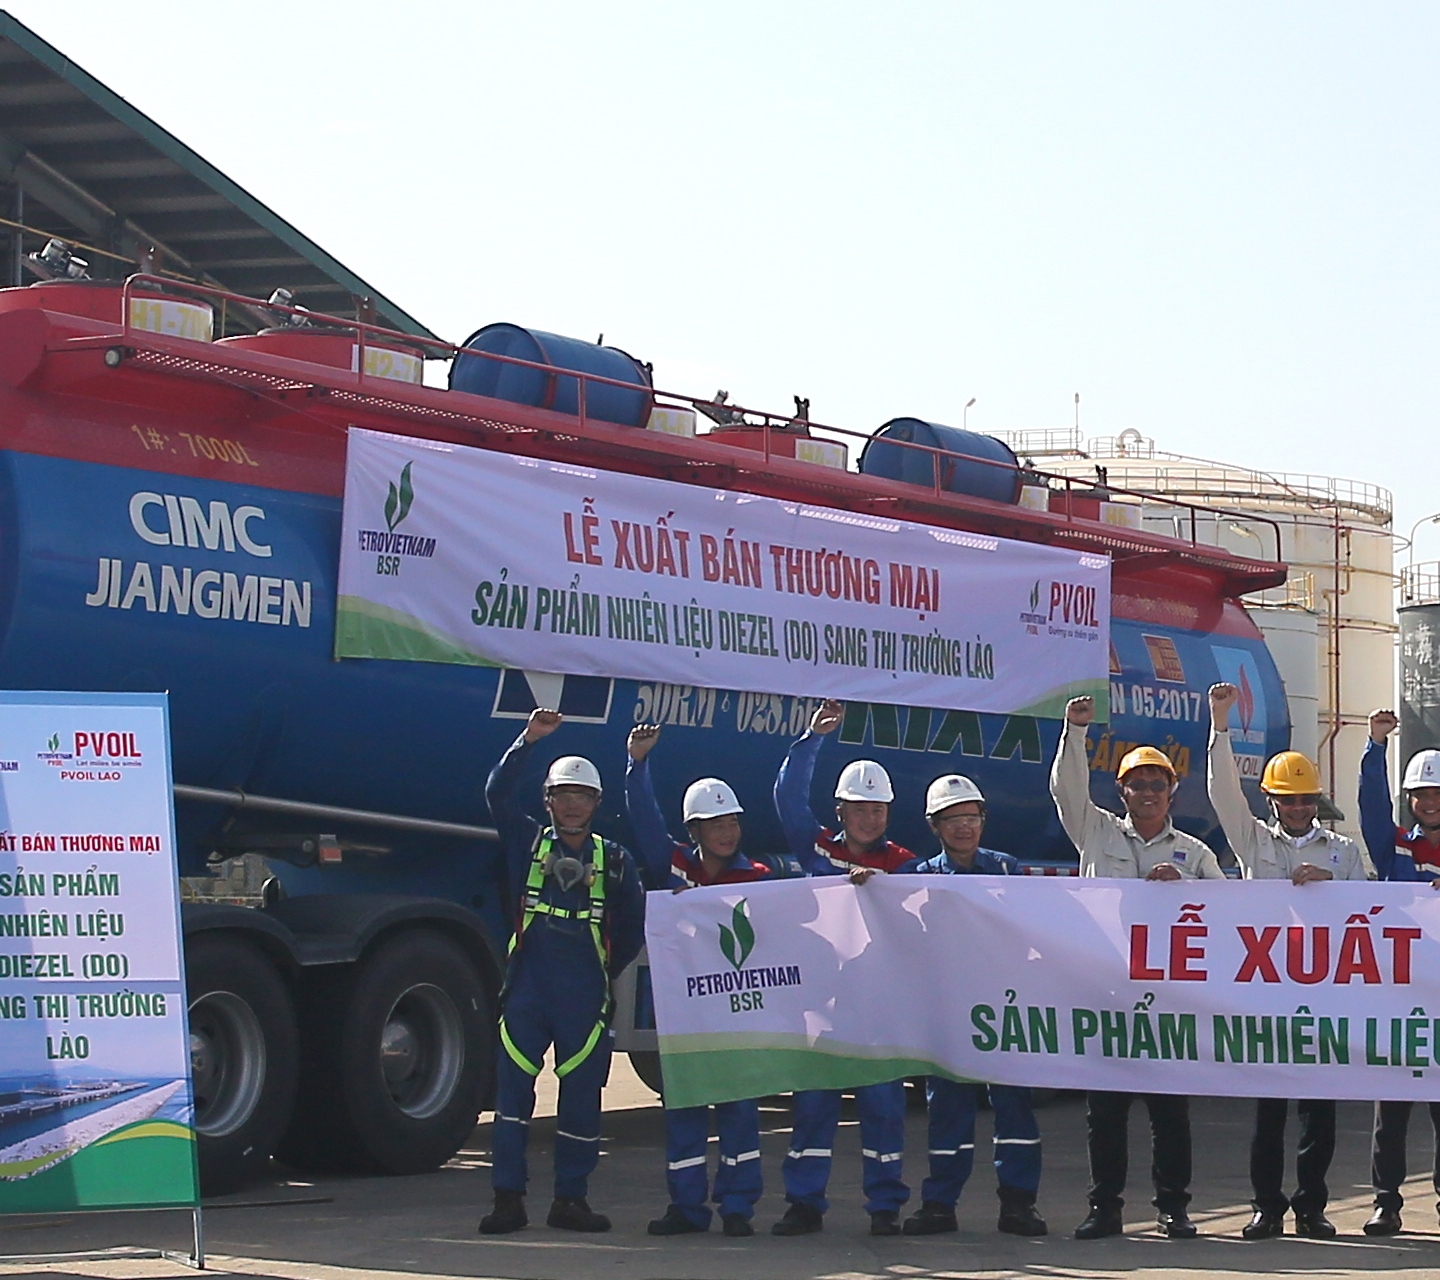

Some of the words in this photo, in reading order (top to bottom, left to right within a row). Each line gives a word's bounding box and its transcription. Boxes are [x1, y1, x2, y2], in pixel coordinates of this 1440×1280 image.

[179, 432, 259, 467] 7000L
[128, 491, 272, 557] CIMC
[376, 556, 401, 576] BSR
[563, 497, 603, 567] LỄ
[610, 510, 691, 579] XUẤT
[700, 528, 762, 590] BÁN
[769, 545, 881, 605] THƯƠNG
[888, 561, 941, 622] MẠI
[86, 557, 312, 628] JIANGMEN
[1048, 581, 1099, 627] PVOIL
[471, 567, 529, 630] SẢN
[536, 573, 601, 638] PHẨM
[607, 592, 669, 645] NHIÊN
[673, 598, 713, 658] LIỆU
[719, 609, 779, 658] DIEZEL
[784, 624, 819, 666] (DO)
[824, 624, 868, 668] SANG
[871, 628, 897, 682] THỊ
[901, 627, 961, 678] TRƯỜNG
[966, 634, 994, 681] LÀO
[1132, 684, 1202, 722] 05.2017
[75, 732, 142, 757] PVOIL
[61, 771, 95, 781] PVOIL
[98, 771, 121, 781] LAO
[22, 832, 56, 852] BÁN
[60, 833, 126, 853] THƯƠNG
[129, 834, 161, 856] MẠI
[52, 865, 120, 897] PHẨM
[73, 912, 125, 943] LIỆU
[1129, 903, 1209, 983] LỄ
[1233, 905, 1422, 986] XUẤT
[82, 953, 129, 980] (DO)
[687, 965, 801, 998] PETROVIETNAM
[33, 994, 69, 1024] THỊ
[75, 987, 167, 1018] TRƯỜNG
[729, 991, 764, 1014] BSR
[970, 989, 1060, 1055] SẢN
[1071, 992, 1199, 1061] PHẨM
[1212, 1005, 1350, 1065] NHIÊN
[46, 1029, 90, 1061] LÀO
